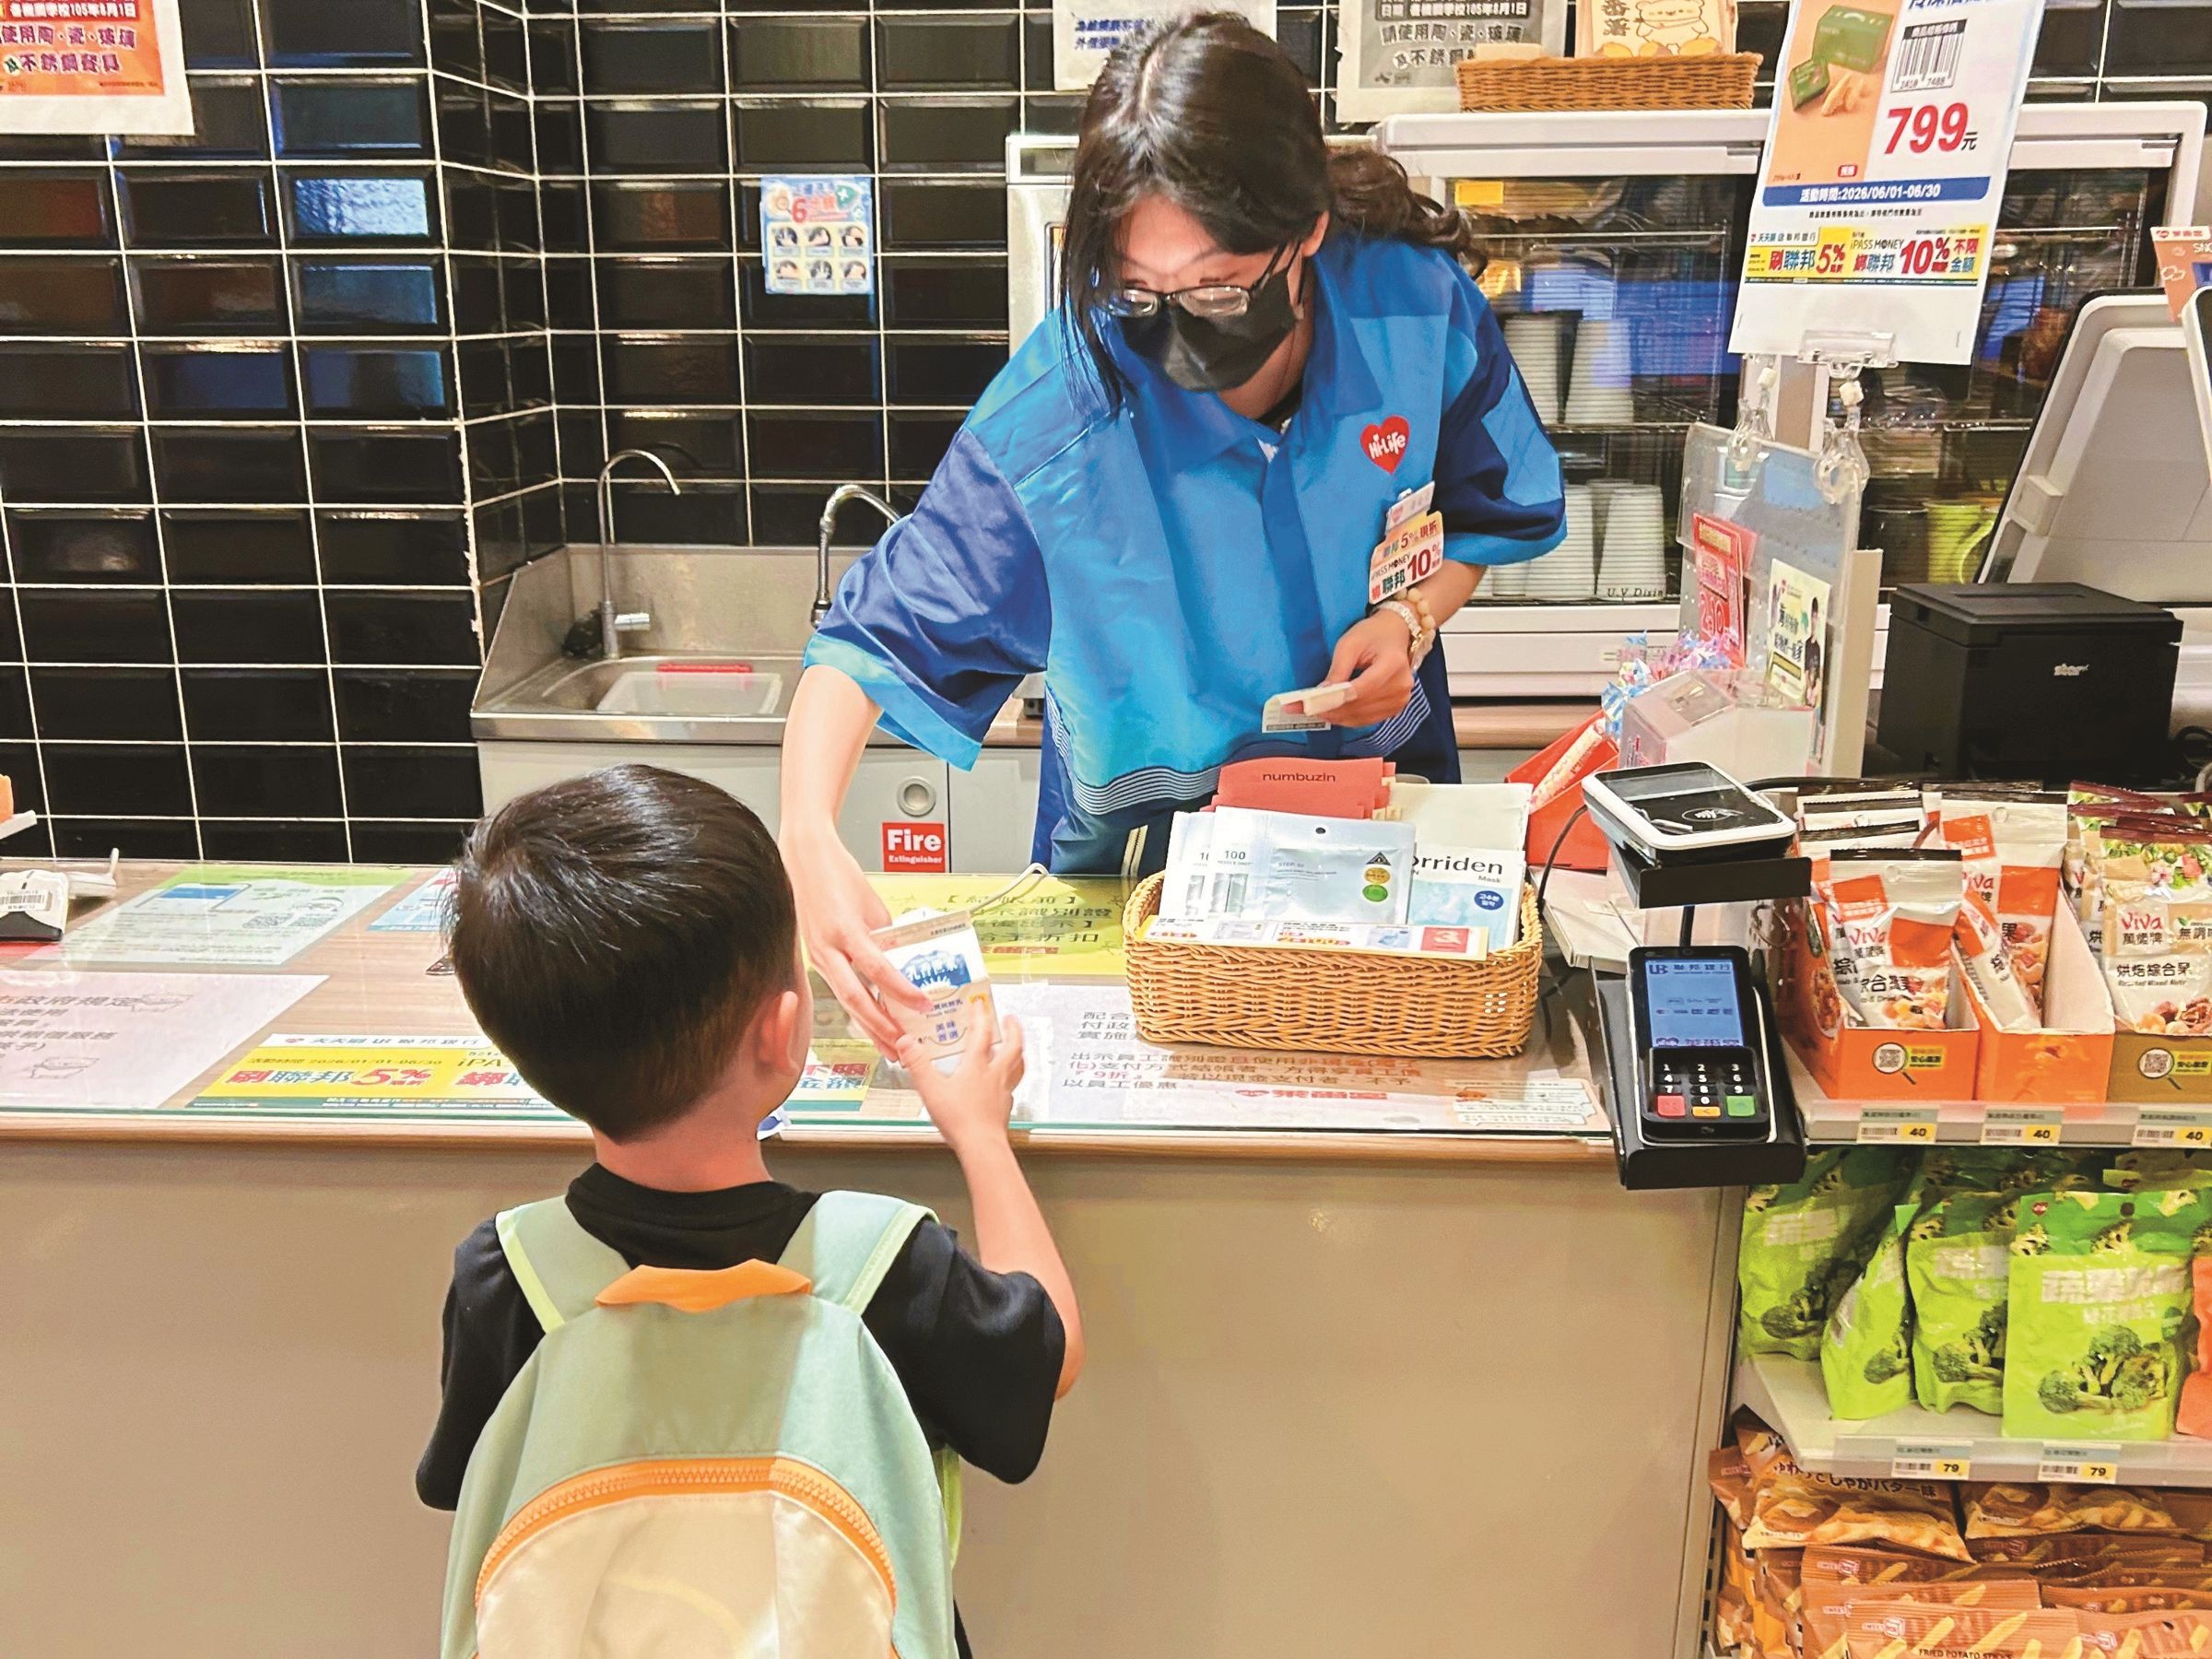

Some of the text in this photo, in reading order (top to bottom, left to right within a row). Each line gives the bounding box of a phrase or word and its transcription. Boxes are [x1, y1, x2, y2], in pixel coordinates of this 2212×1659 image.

[1885, 102, 1978, 155] 799 元
[1263, 772, 1336, 782] numbuzin
[887, 829, 942, 852] Fire
[888, 854, 942, 865] Extinguisher
[1224, 850, 1246, 860] 100
[1664, 1074, 1742, 1082] 4 5 6
[1665, 1085, 1744, 1093] 7 8 9
[1700, 1096, 1710, 1104] 0
[1910, 1127, 1926, 1137] 40
[2033, 1129, 2050, 1138] 40
[2185, 1131, 2204, 1141] 40
[1943, 1464, 1959, 1473] 79
[2089, 1466, 2107, 1477] 79
